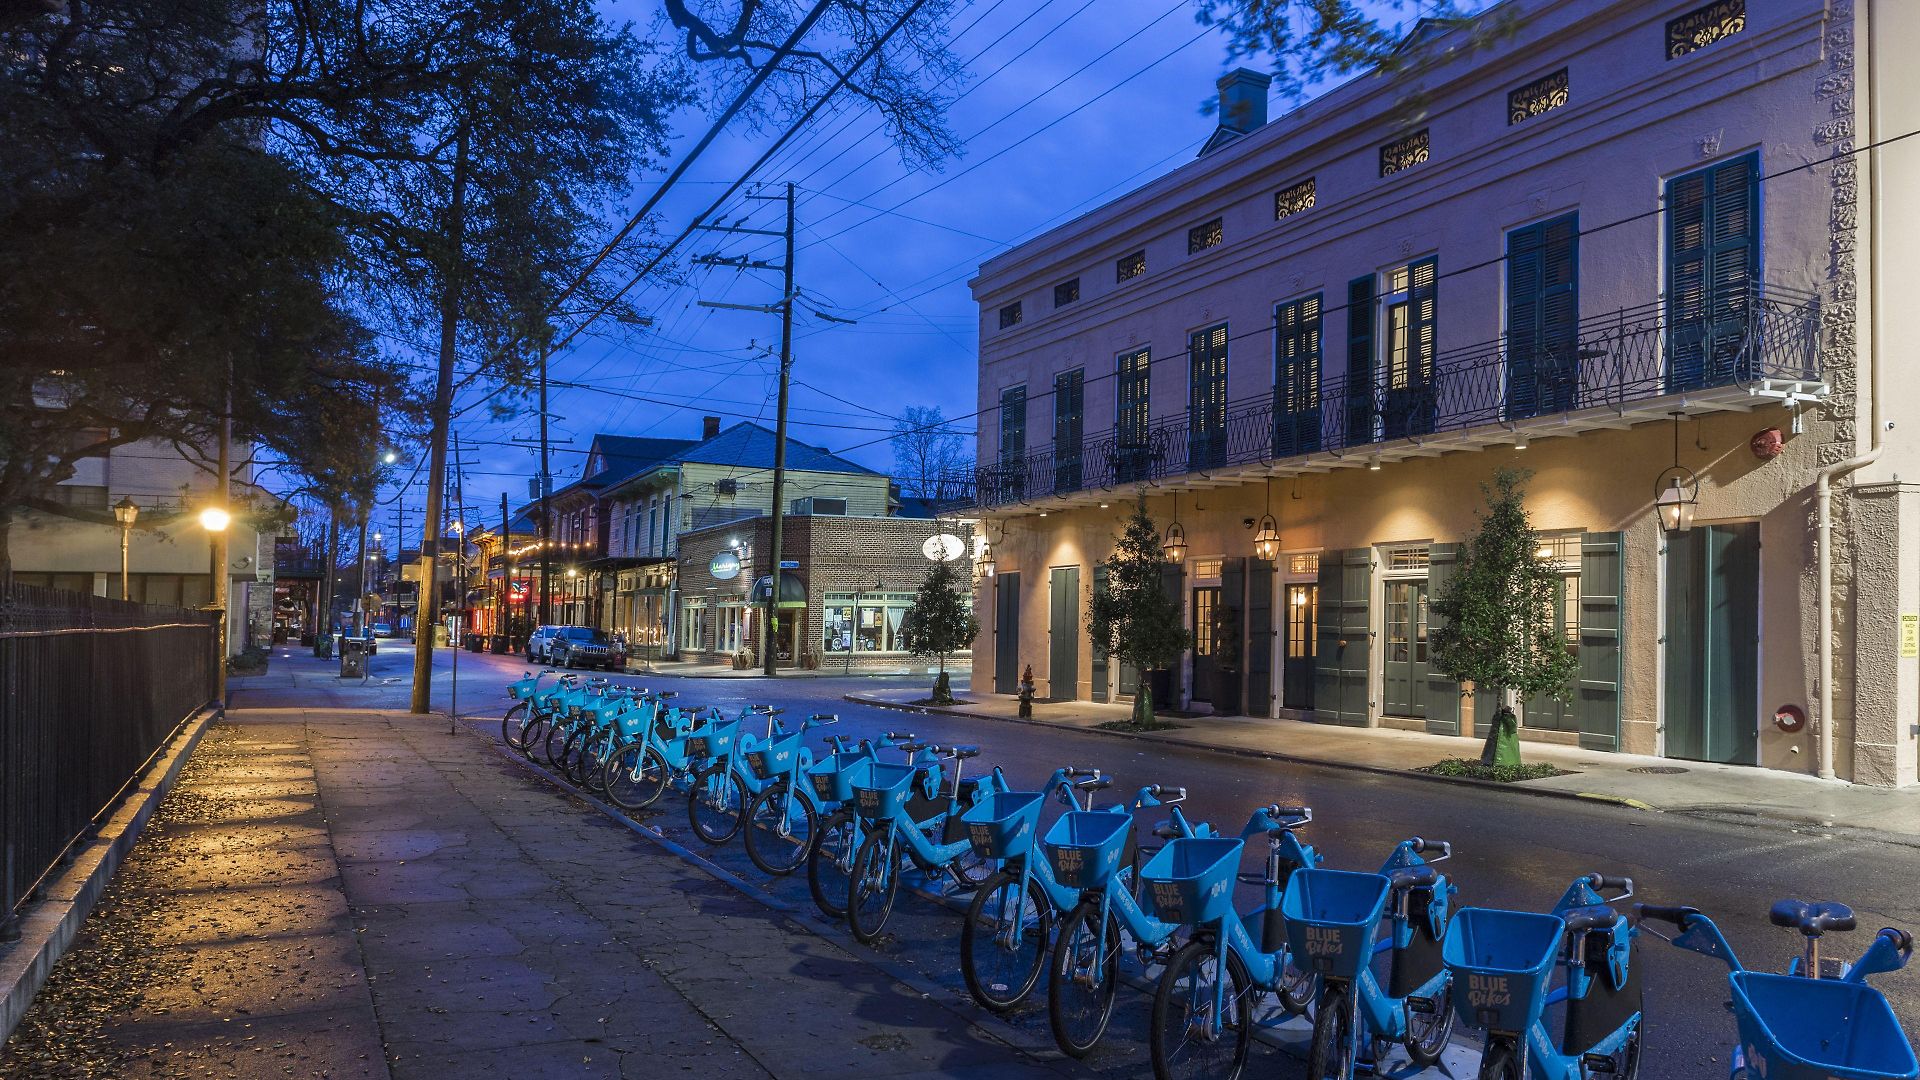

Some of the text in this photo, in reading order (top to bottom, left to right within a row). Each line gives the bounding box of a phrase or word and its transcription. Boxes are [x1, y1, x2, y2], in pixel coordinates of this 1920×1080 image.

[860, 790, 878, 800] BLUE
[970, 826, 989, 835] BLUE
[1058, 849, 1082, 860] BLUE
[1153, 883, 1180, 895] BLUE
[1156, 894, 1184, 908] Bikes
[1306, 927, 1340, 942] BLUE
[1305, 940, 1343, 956] Bikes
[1468, 974, 1508, 992] BLUE
[1468, 990, 1511, 1008] Bikes
